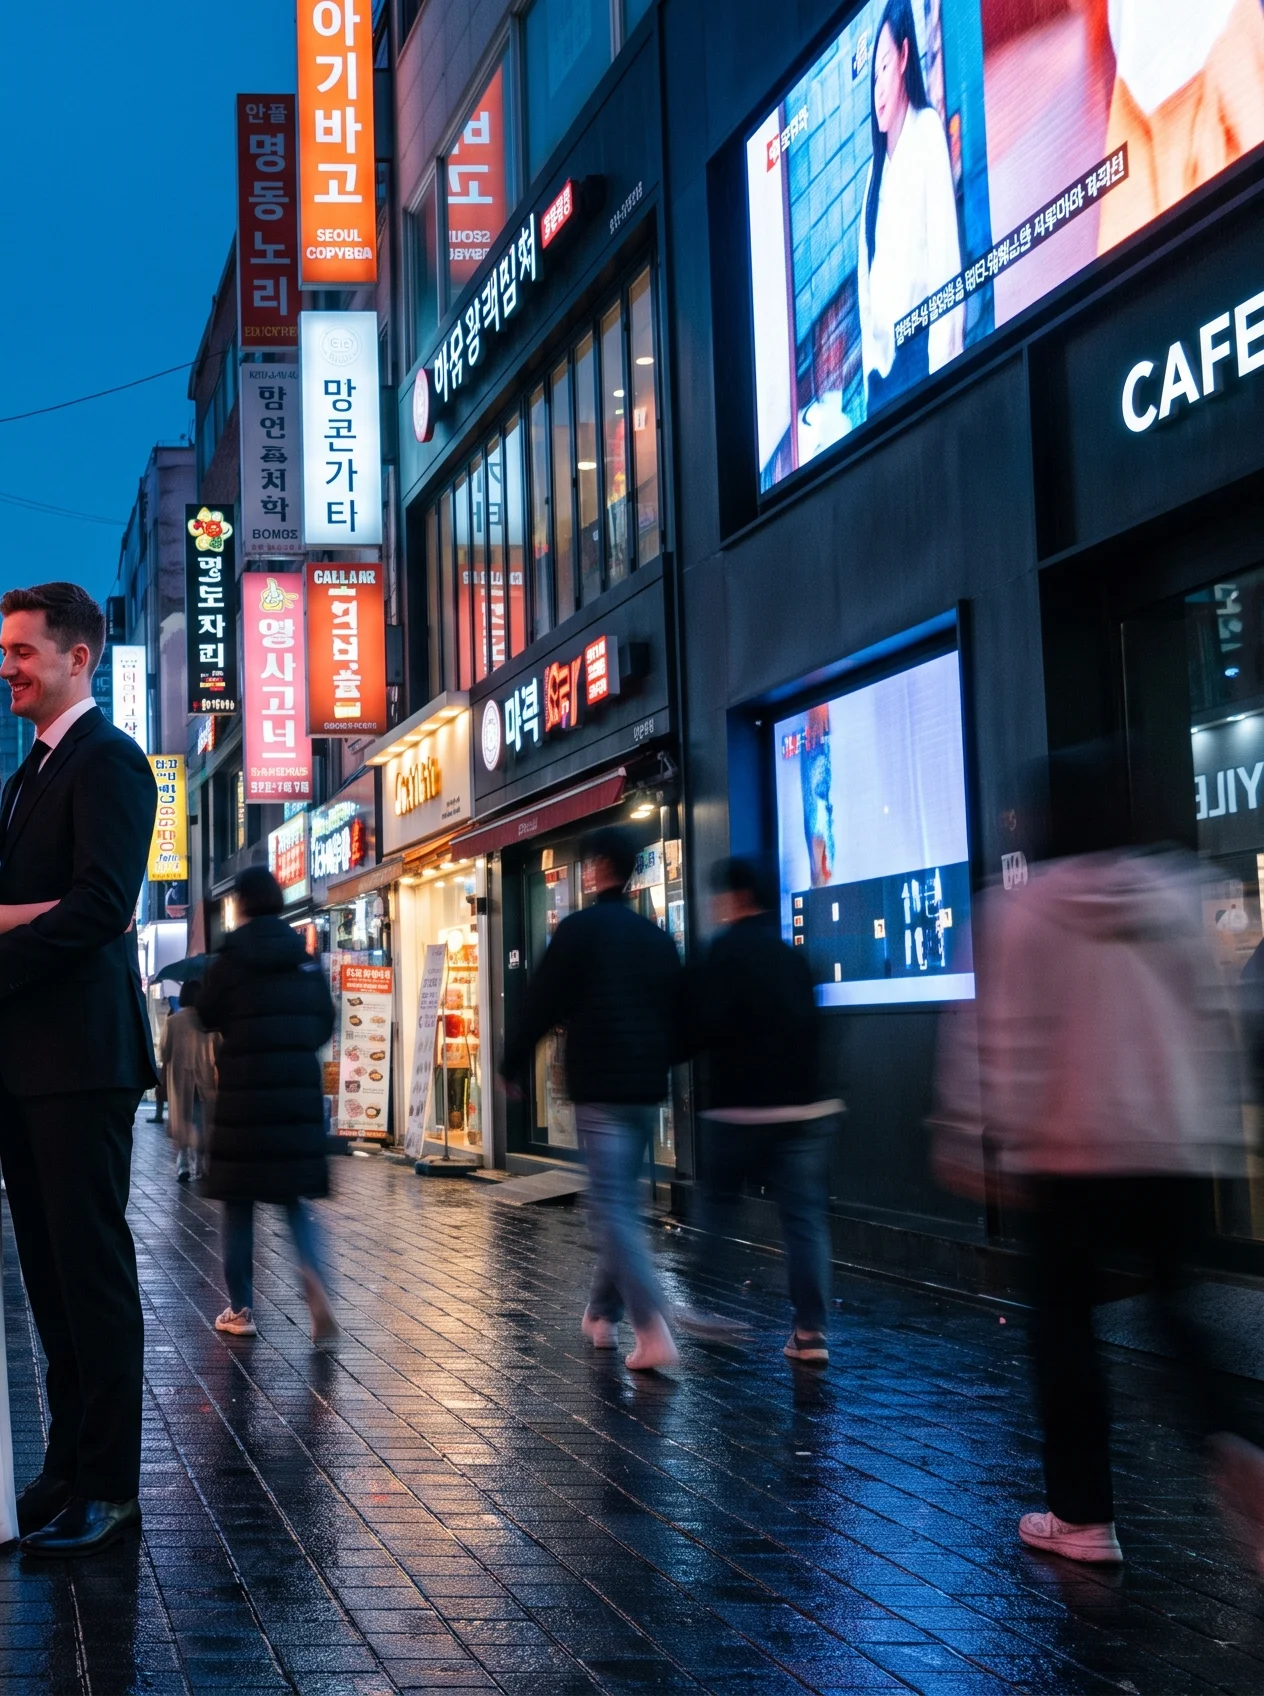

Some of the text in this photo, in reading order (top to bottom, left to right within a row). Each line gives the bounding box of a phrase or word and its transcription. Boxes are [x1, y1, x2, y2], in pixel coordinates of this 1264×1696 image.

[313, 0, 362, 203] 아기바고
[248, 133, 292, 316] 명동노리
[316, 228, 363, 242] SEOUL
[1121, 291, 1264, 433] CAFE
[324, 378, 358, 533] 망콘가타
